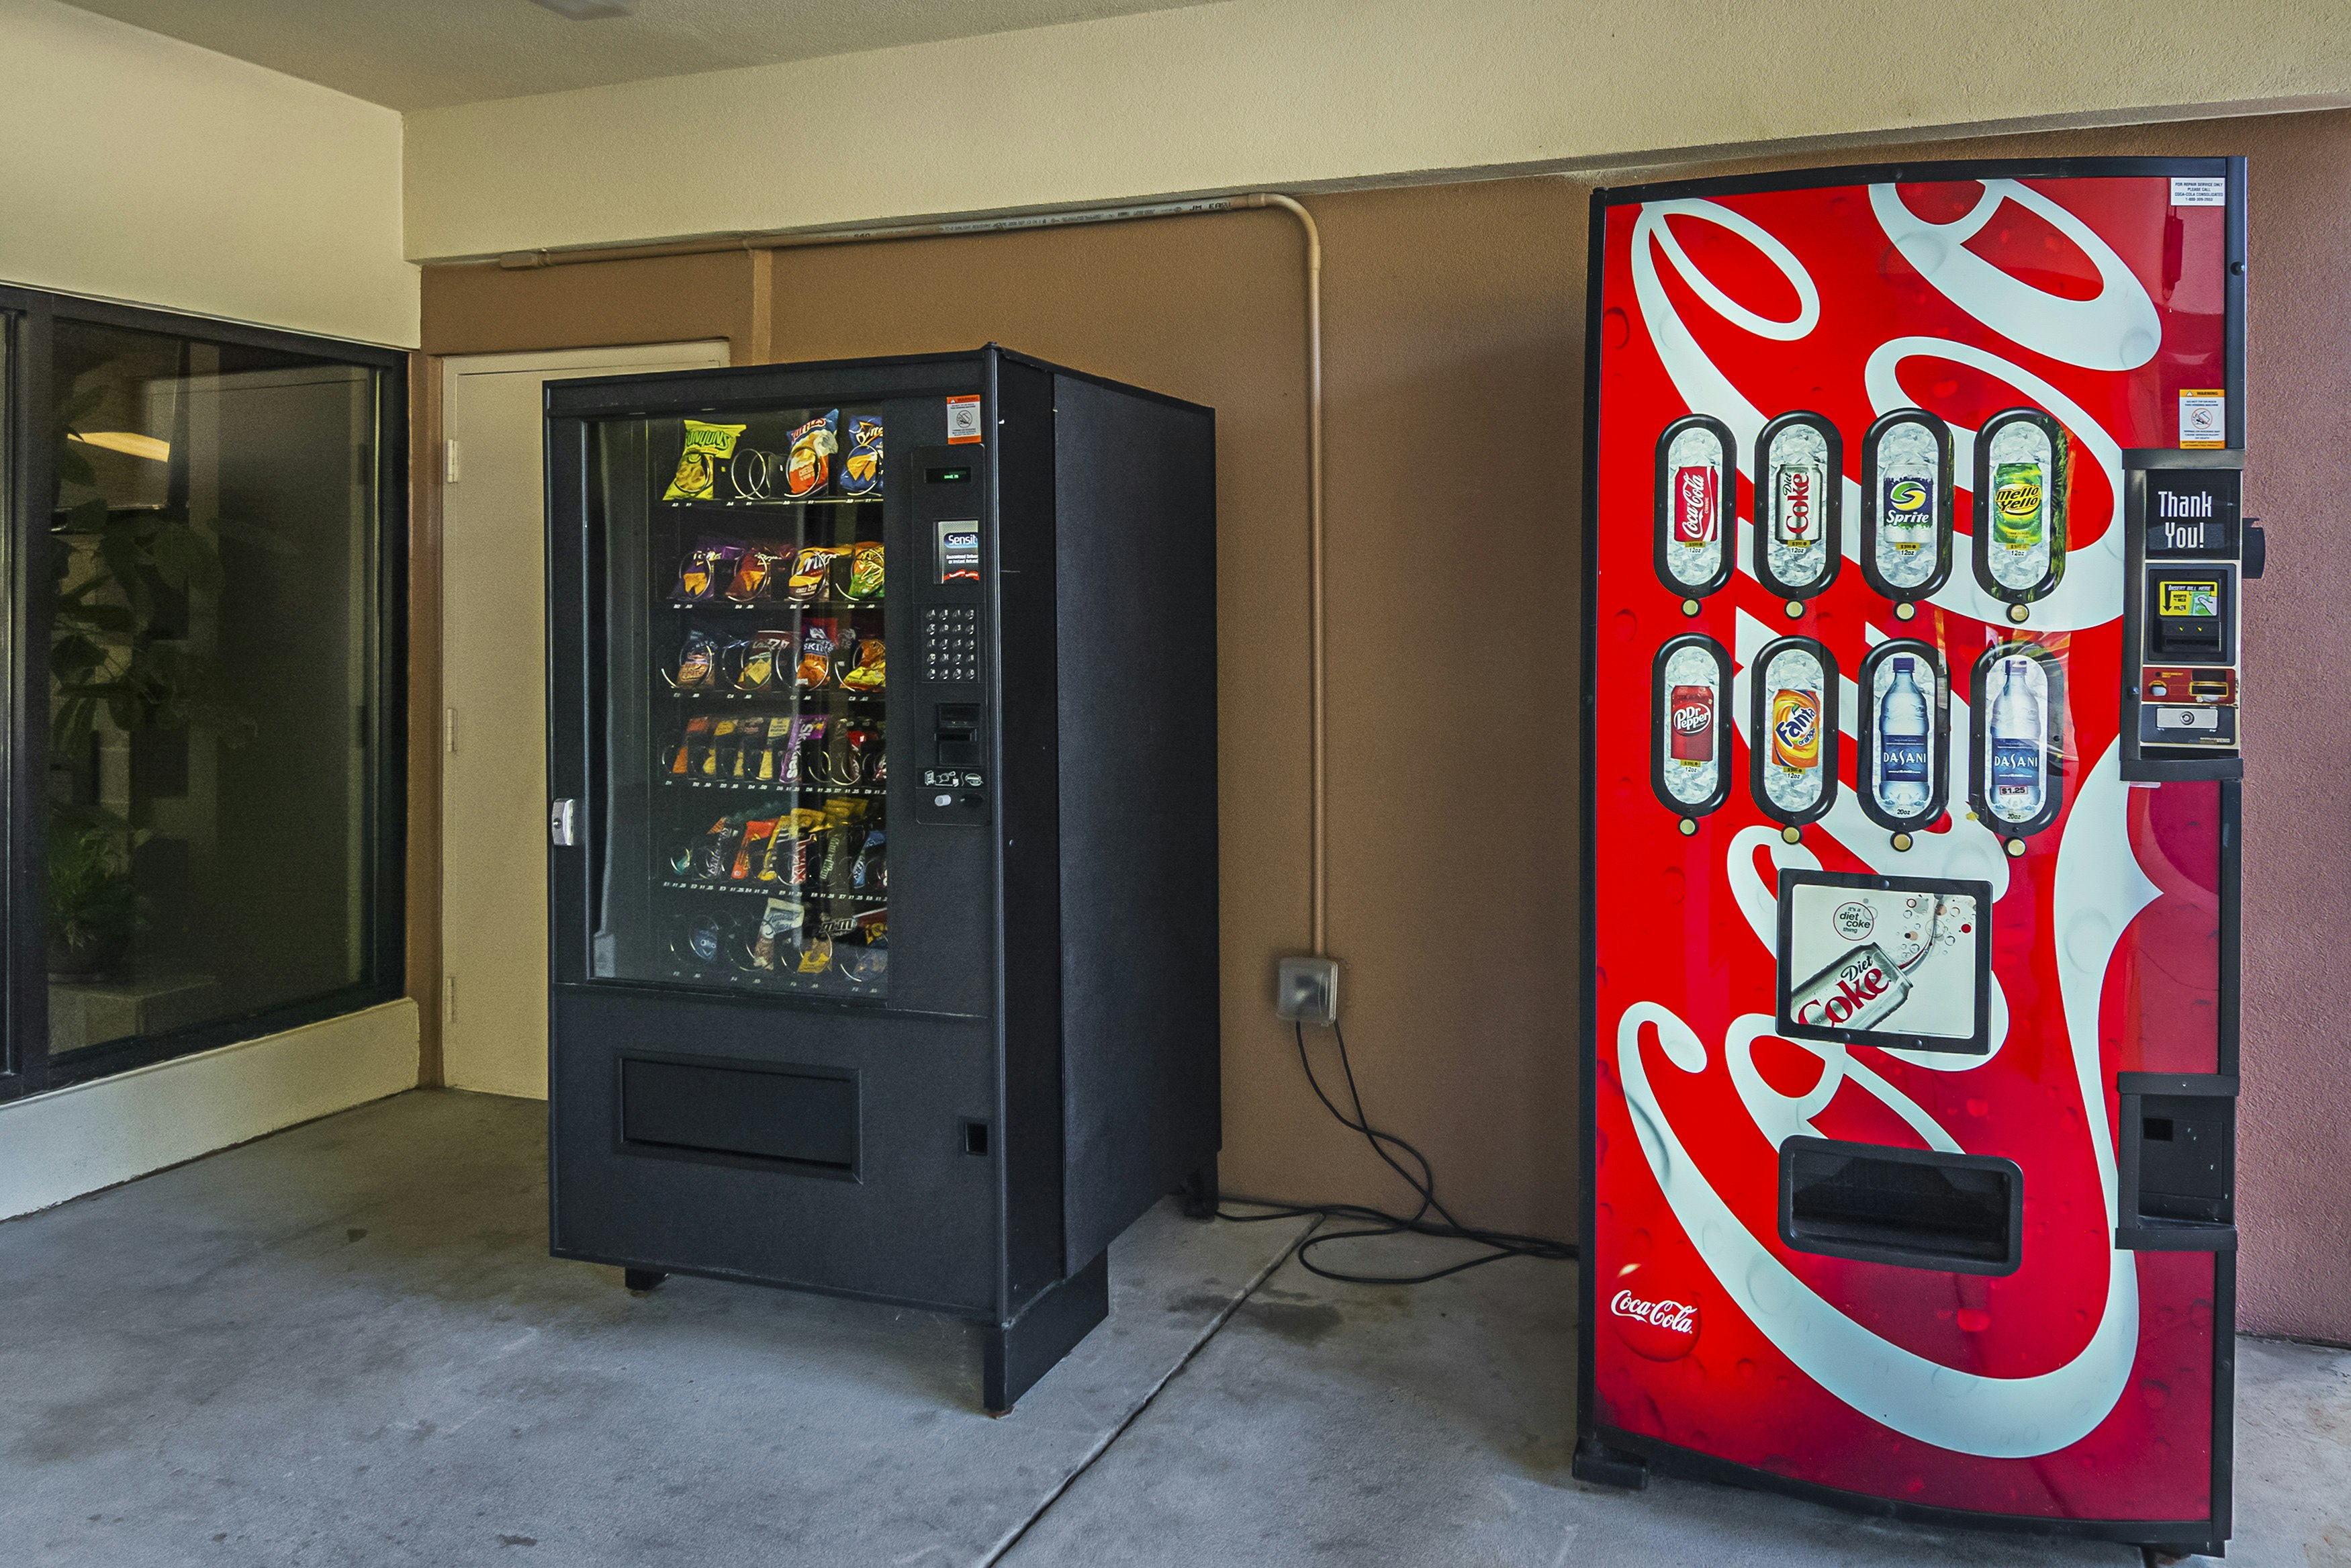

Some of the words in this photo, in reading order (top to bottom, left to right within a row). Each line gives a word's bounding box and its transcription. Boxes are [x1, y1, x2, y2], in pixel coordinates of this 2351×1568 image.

[1783, 473, 1792, 496] Diet
[1786, 473, 1810, 534] Coke
[2000, 497, 2038, 512] Yello
[2158, 491, 2212, 517] Thank
[1886, 510, 1929, 525] Sprite
[2165, 522, 2204, 549] You!
[1675, 709, 1710, 731] Pepper
[1686, 706, 1701, 719] Dr
[1775, 708, 1816, 747] Fanta
[1798, 728, 1816, 745] orange
[1883, 749, 1926, 766] DASANI
[1994, 753, 2037, 769] DASANI
[1839, 911, 1859, 921] diet
[1846, 919, 1871, 929] coke
[1841, 955, 1874, 982] Diet
[1798, 968, 1890, 1028] Coke
[1610, 1289, 1698, 1334] Coca-Cola
